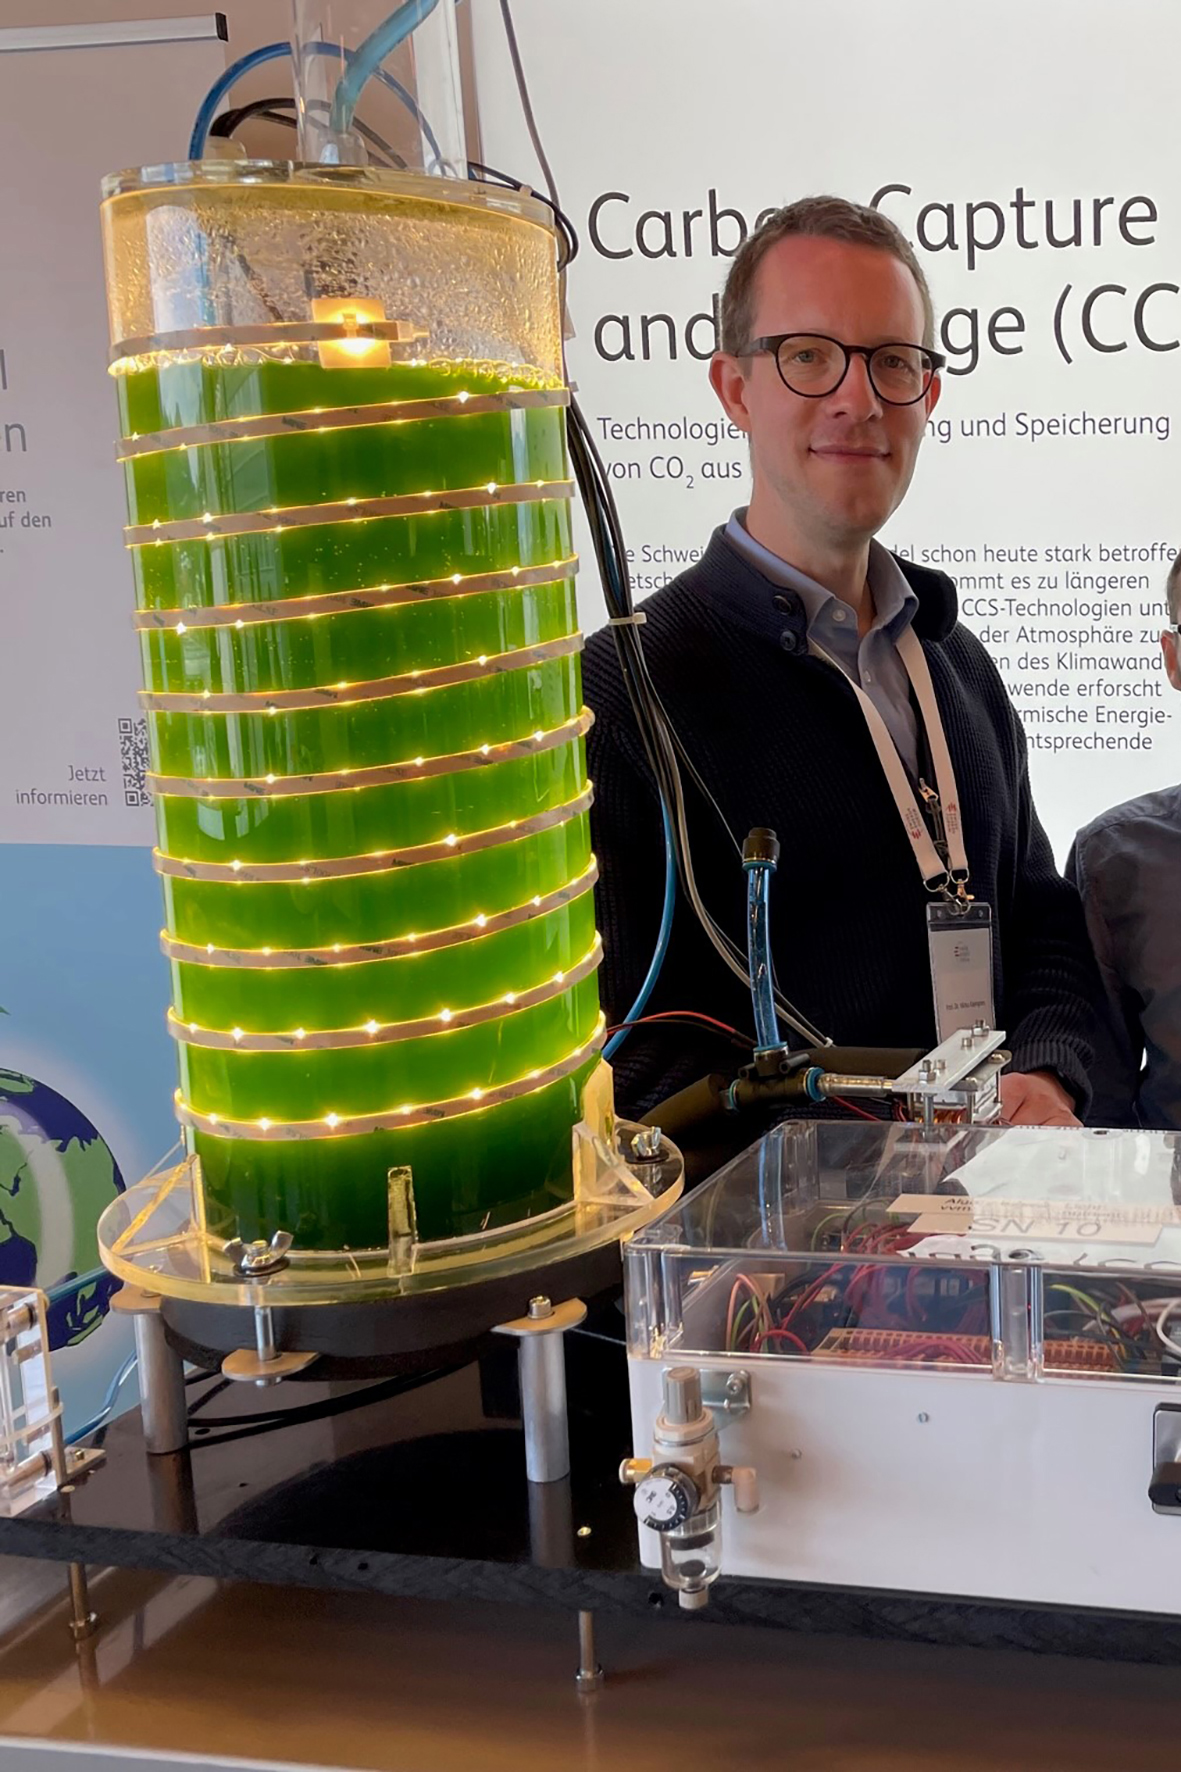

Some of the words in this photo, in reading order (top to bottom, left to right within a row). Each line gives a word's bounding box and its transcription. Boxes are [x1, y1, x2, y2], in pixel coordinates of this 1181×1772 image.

[594, 293, 720, 361] and
[597, 416, 746, 446] Technologie
[960, 413, 1006, 436] und
[1015, 411, 1170, 442] Speicherung
[701, 461, 742, 479] aus
[21, 510, 51, 528] den
[921, 544, 976, 563] schon
[984, 544, 1037, 562] heute
[1045, 544, 1092, 562] stark
[1100, 542, 1181, 562] betroffe
[1011, 576, 1030, 589] es
[1038, 576, 1058, 589] zu
[1065, 571, 1149, 594] längeren
[962, 598, 1131, 621] CCS-Technologien
[979, 626, 1009, 643] der
[1016, 625, 1133, 647] Atmosphäre
[1017, 651, 1050, 670] des
[1057, 651, 1162, 670] Klimawand
[1077, 678, 1162, 696] erforscht
[1096, 705, 1172, 728] Energie-
[68, 765, 107, 781] Jetzt
[15, 788, 108, 805] informieren
[970, 1217, 1034, 1234] SN
